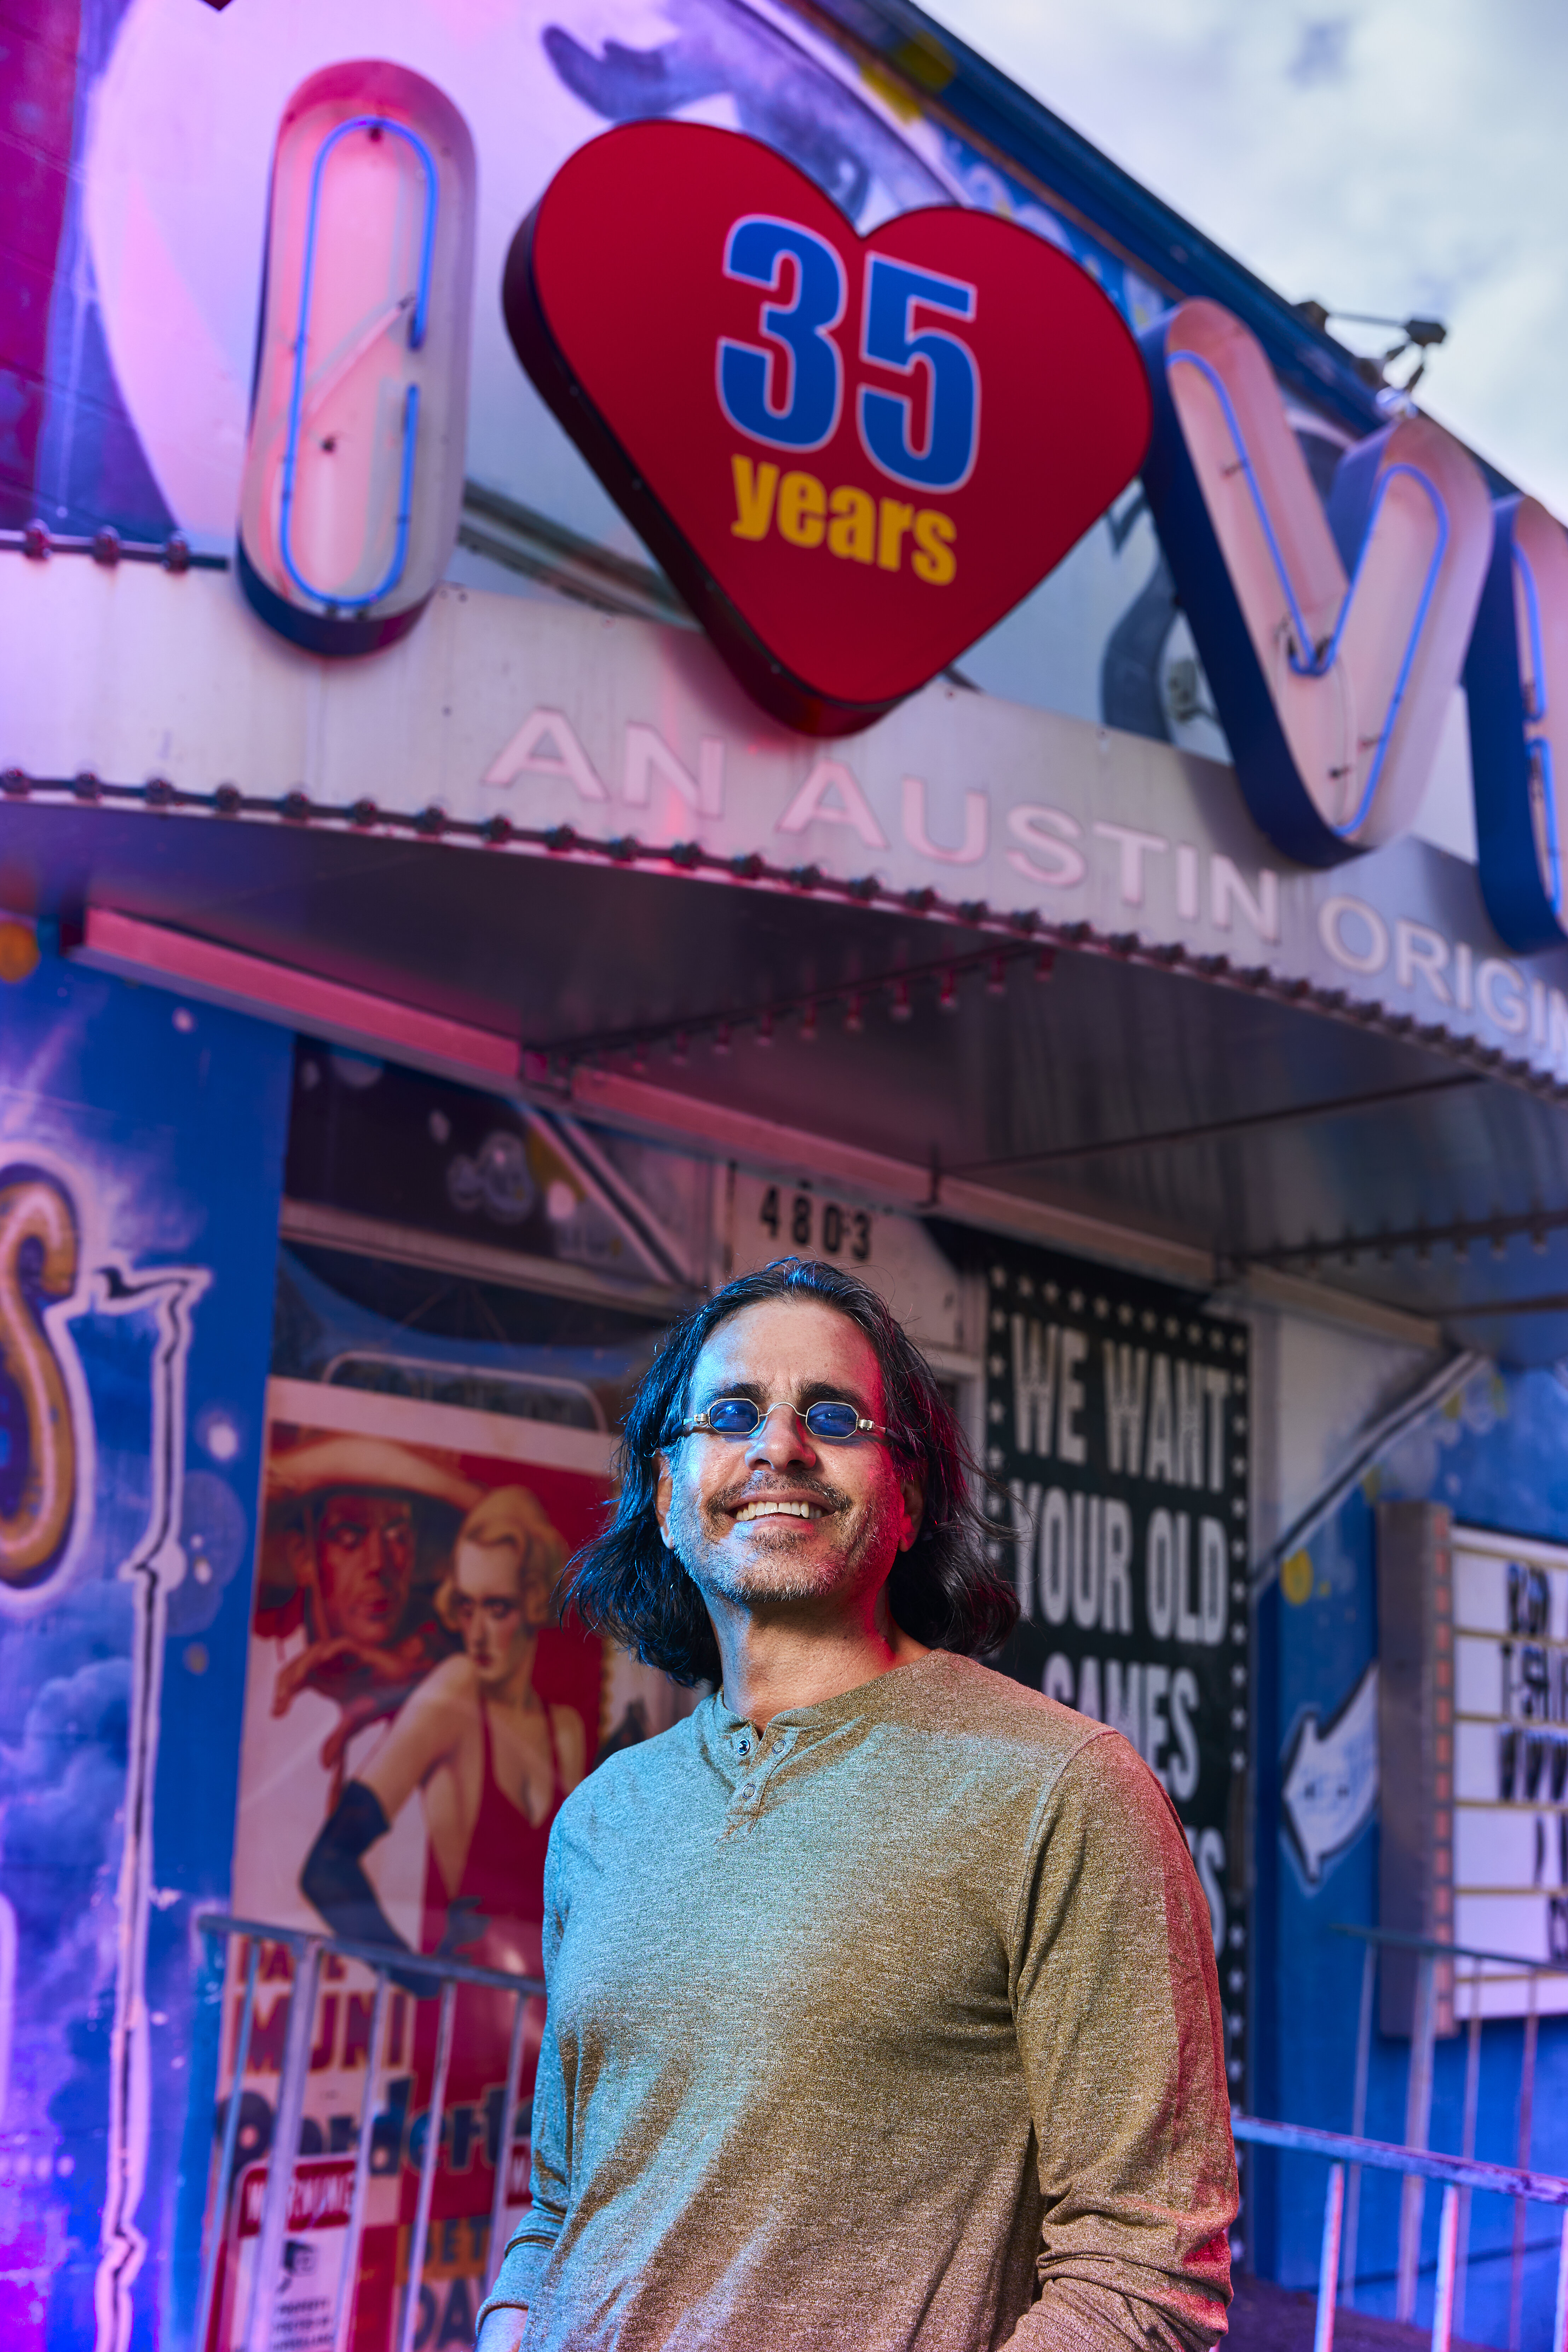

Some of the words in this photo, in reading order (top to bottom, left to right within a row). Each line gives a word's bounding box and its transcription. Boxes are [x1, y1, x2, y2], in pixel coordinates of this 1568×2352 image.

[715, 214, 982, 495] 35
[731, 453, 957, 587] years
[483, 706, 724, 819] AN
[778, 757, 1281, 944] AUSTIN
[761, 1185, 871, 1260] 4803
[1010, 1311, 1089, 1466] WE
[1101, 1337, 1230, 1493] WANT
[1010, 1476, 1133, 1637] YOUR
[1146, 1506, 1230, 1647] OLD
